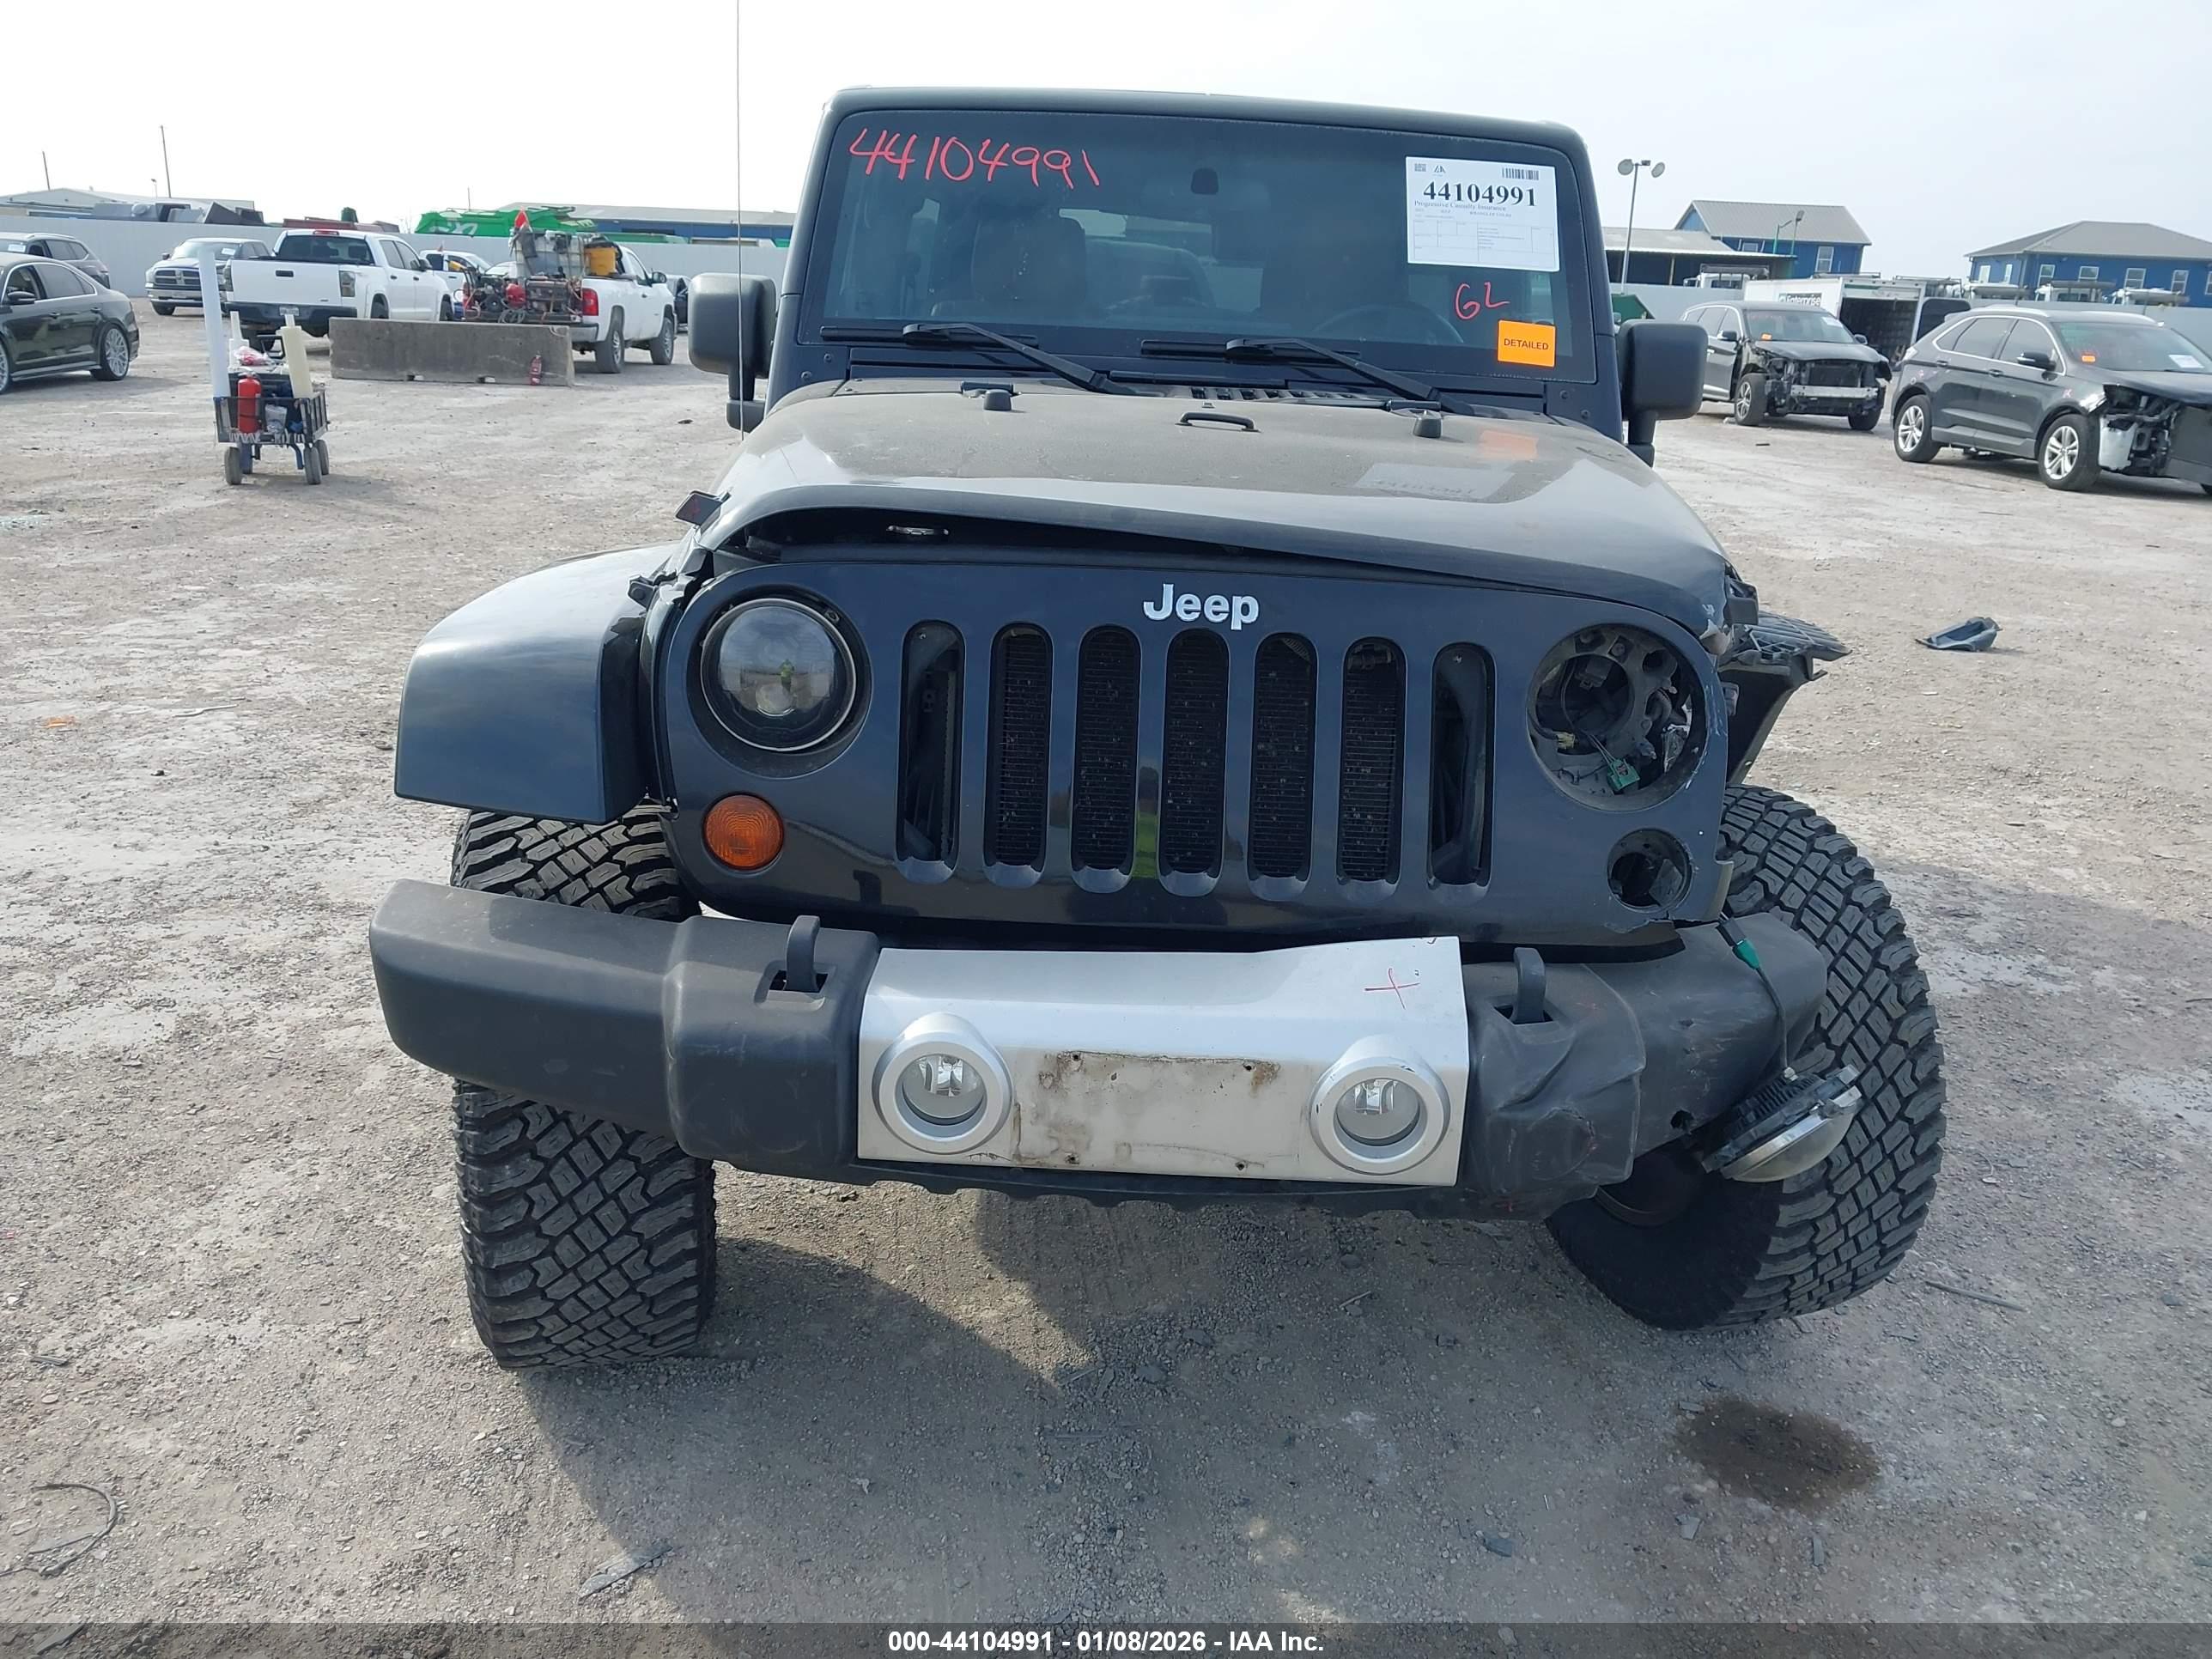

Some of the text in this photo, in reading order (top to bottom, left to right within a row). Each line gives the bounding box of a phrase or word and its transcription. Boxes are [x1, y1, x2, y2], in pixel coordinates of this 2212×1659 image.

[848, 128, 1101, 190] 44104991
[1423, 181, 1537, 207] 44104991
[1787, 294, 1821, 307] Enterprise
[1504, 337, 1549, 350] DETAILED
[1143, 583, 1260, 630] Jeep
